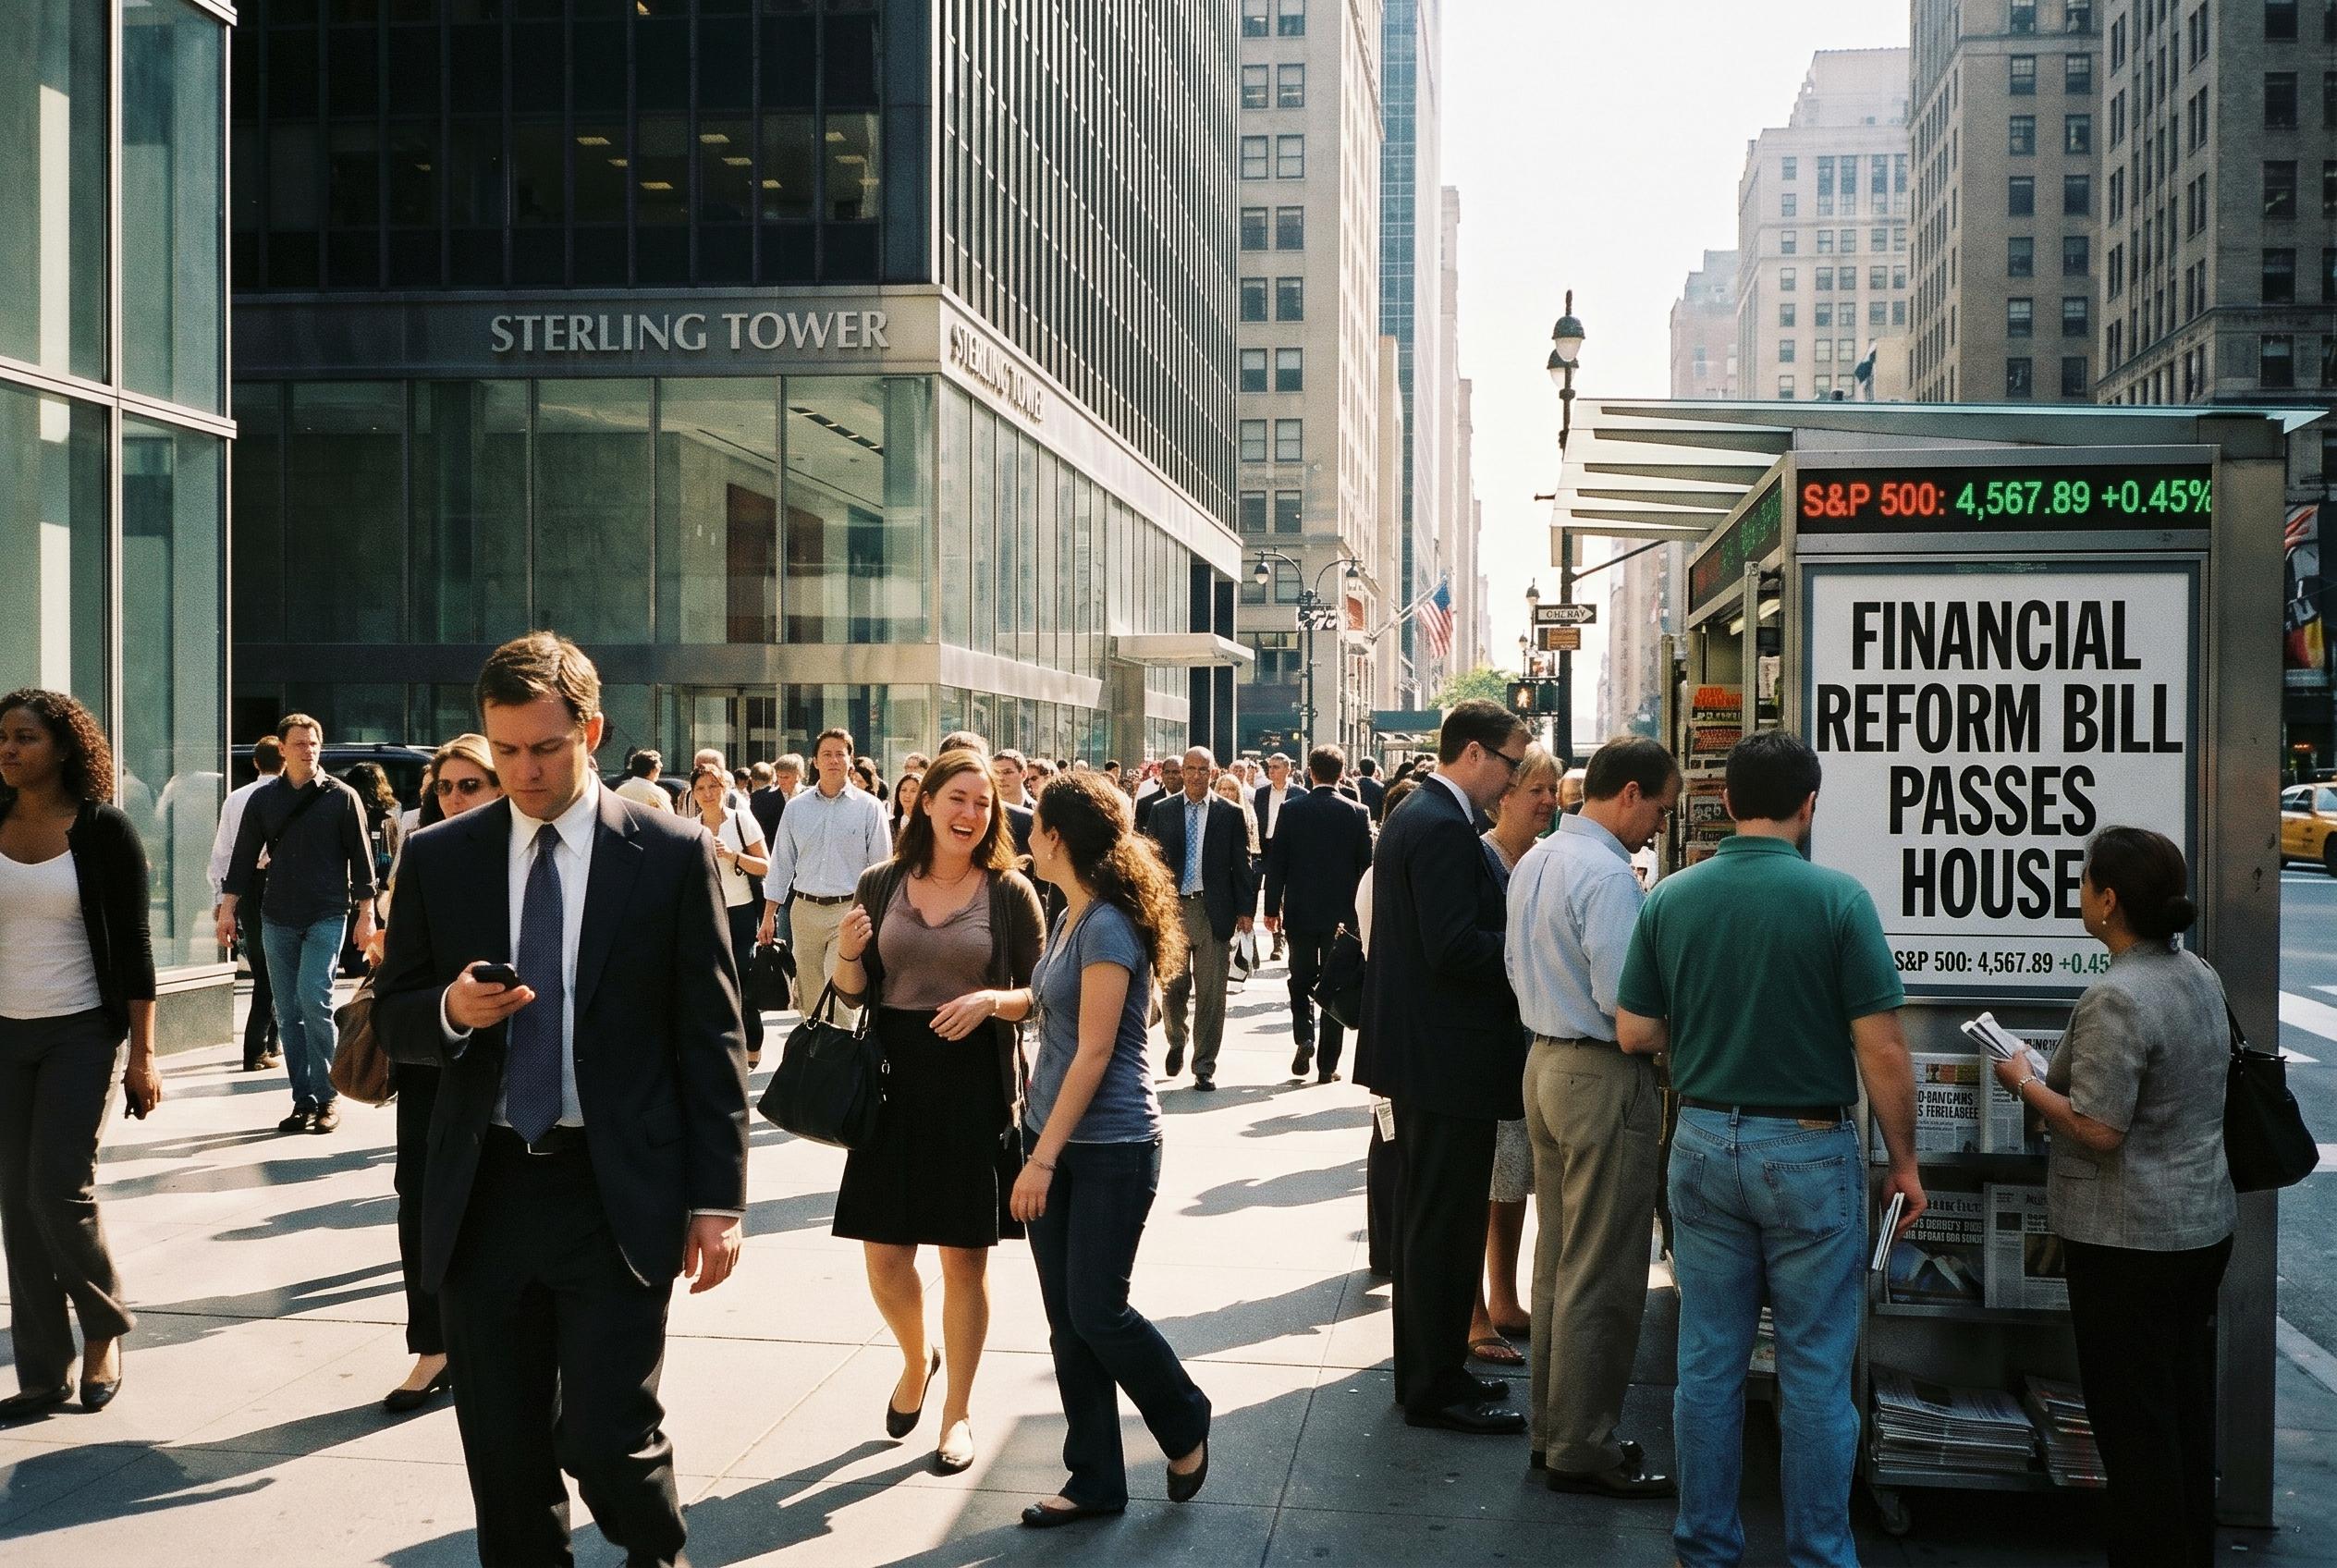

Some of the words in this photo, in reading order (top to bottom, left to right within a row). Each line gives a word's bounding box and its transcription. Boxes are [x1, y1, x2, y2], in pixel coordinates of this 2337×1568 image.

[491, 312, 707, 352] STERLING
[722, 311, 890, 349] TOWER
[1804, 483, 1871, 518] S&P
[1880, 482, 1945, 516] 500:
[1955, 481, 2090, 521] 4,567.89
[2101, 479, 2212, 514] +0.45%
[1852, 599, 2142, 671] FINANCIAL
[1817, 683, 2041, 753] REFORM
[2062, 683, 2184, 753] BILL
[1890, 765, 2098, 837] PASSES
[1902, 847, 2085, 920] HOUSE
[1894, 950, 1929, 972] S&P
[1935, 950, 1972, 973] 500:
[1977, 951, 2053, 976] 4,567.89
